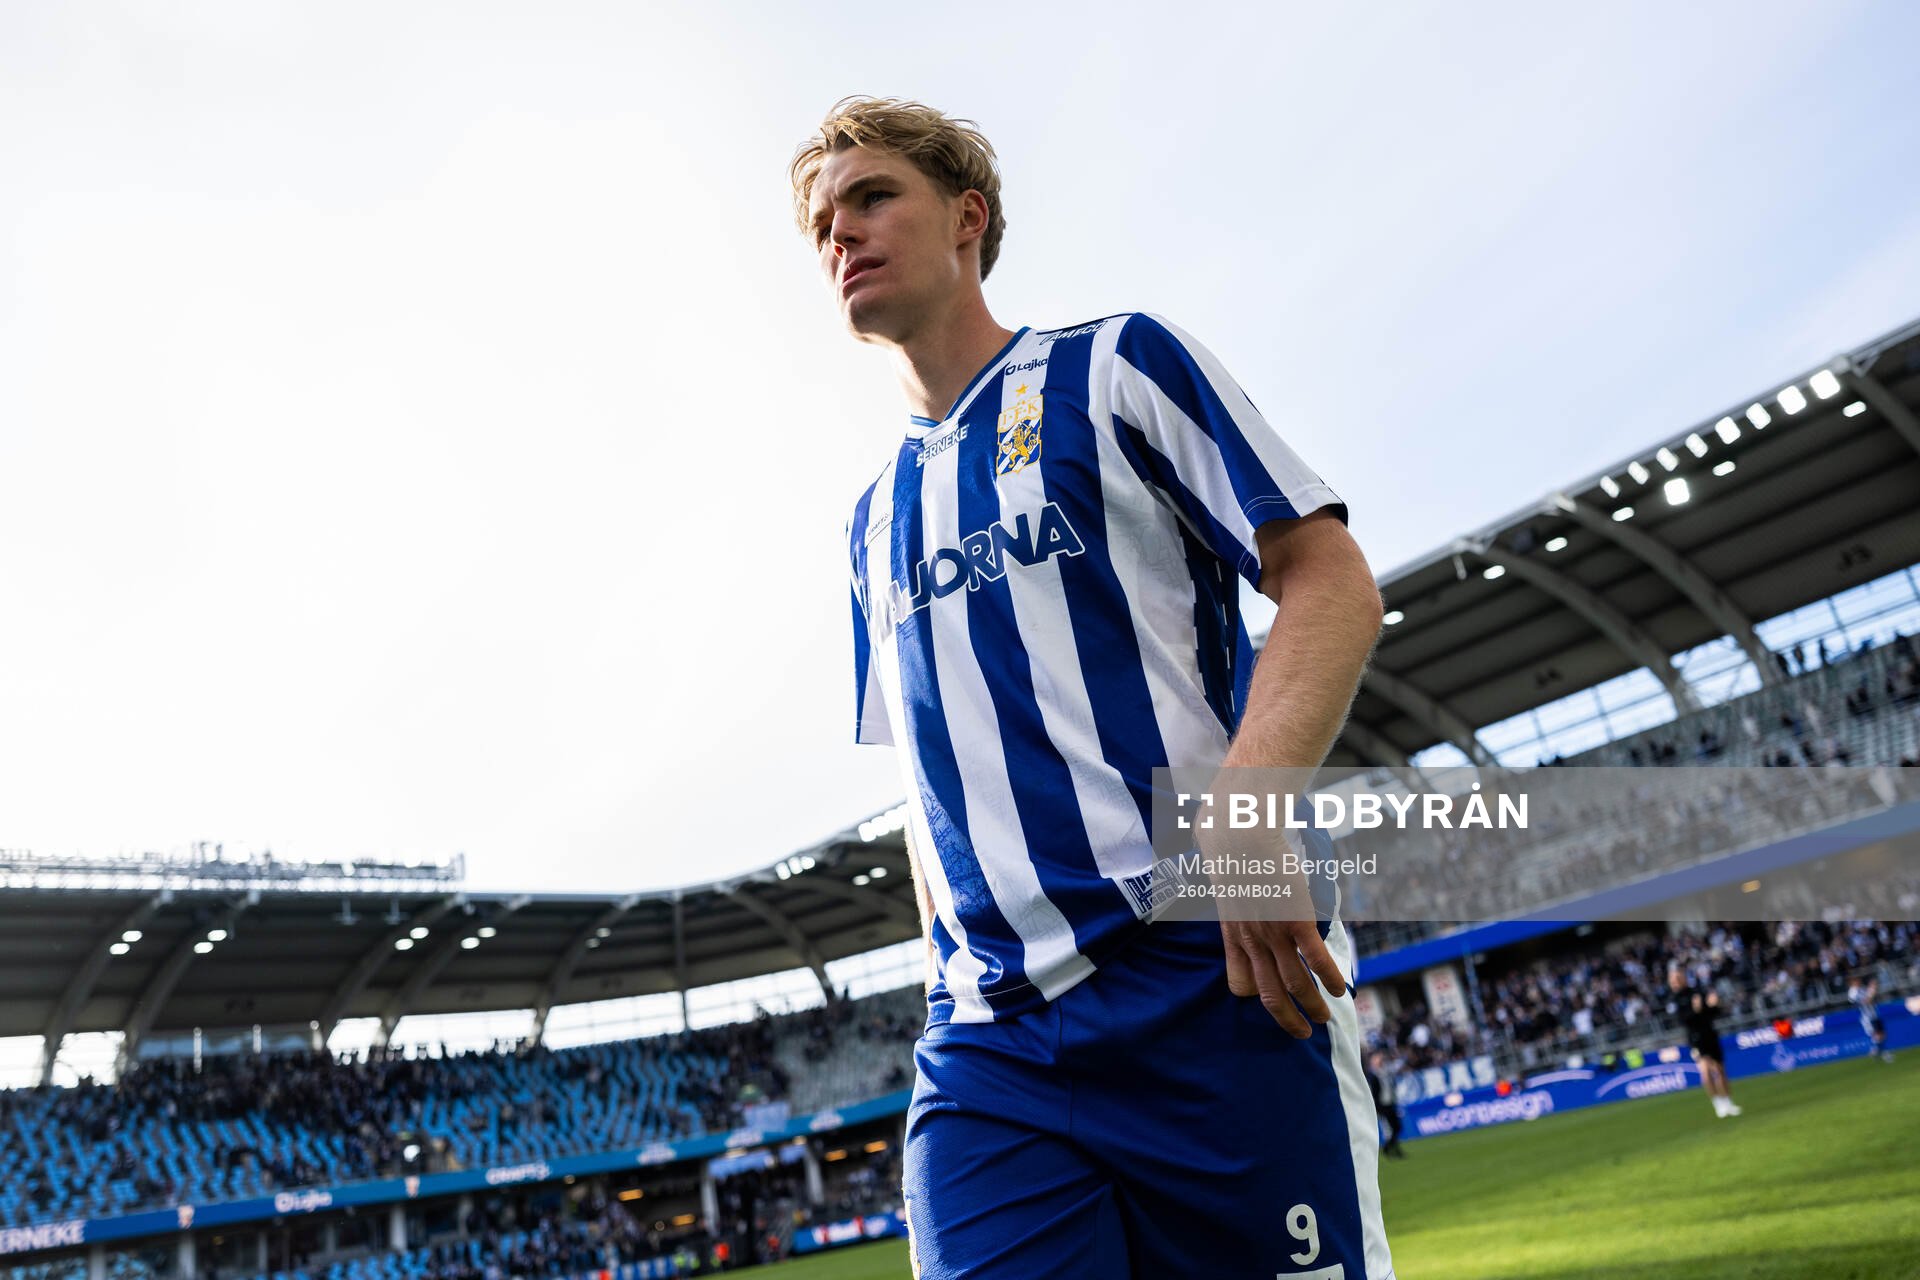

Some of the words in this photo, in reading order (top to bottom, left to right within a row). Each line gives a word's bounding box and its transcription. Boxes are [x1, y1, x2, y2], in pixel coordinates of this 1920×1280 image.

[1017, 358, 1048, 372] Lajka
[916, 423, 970, 468] SERNEKE
[1285, 1203, 1321, 1266] 9
